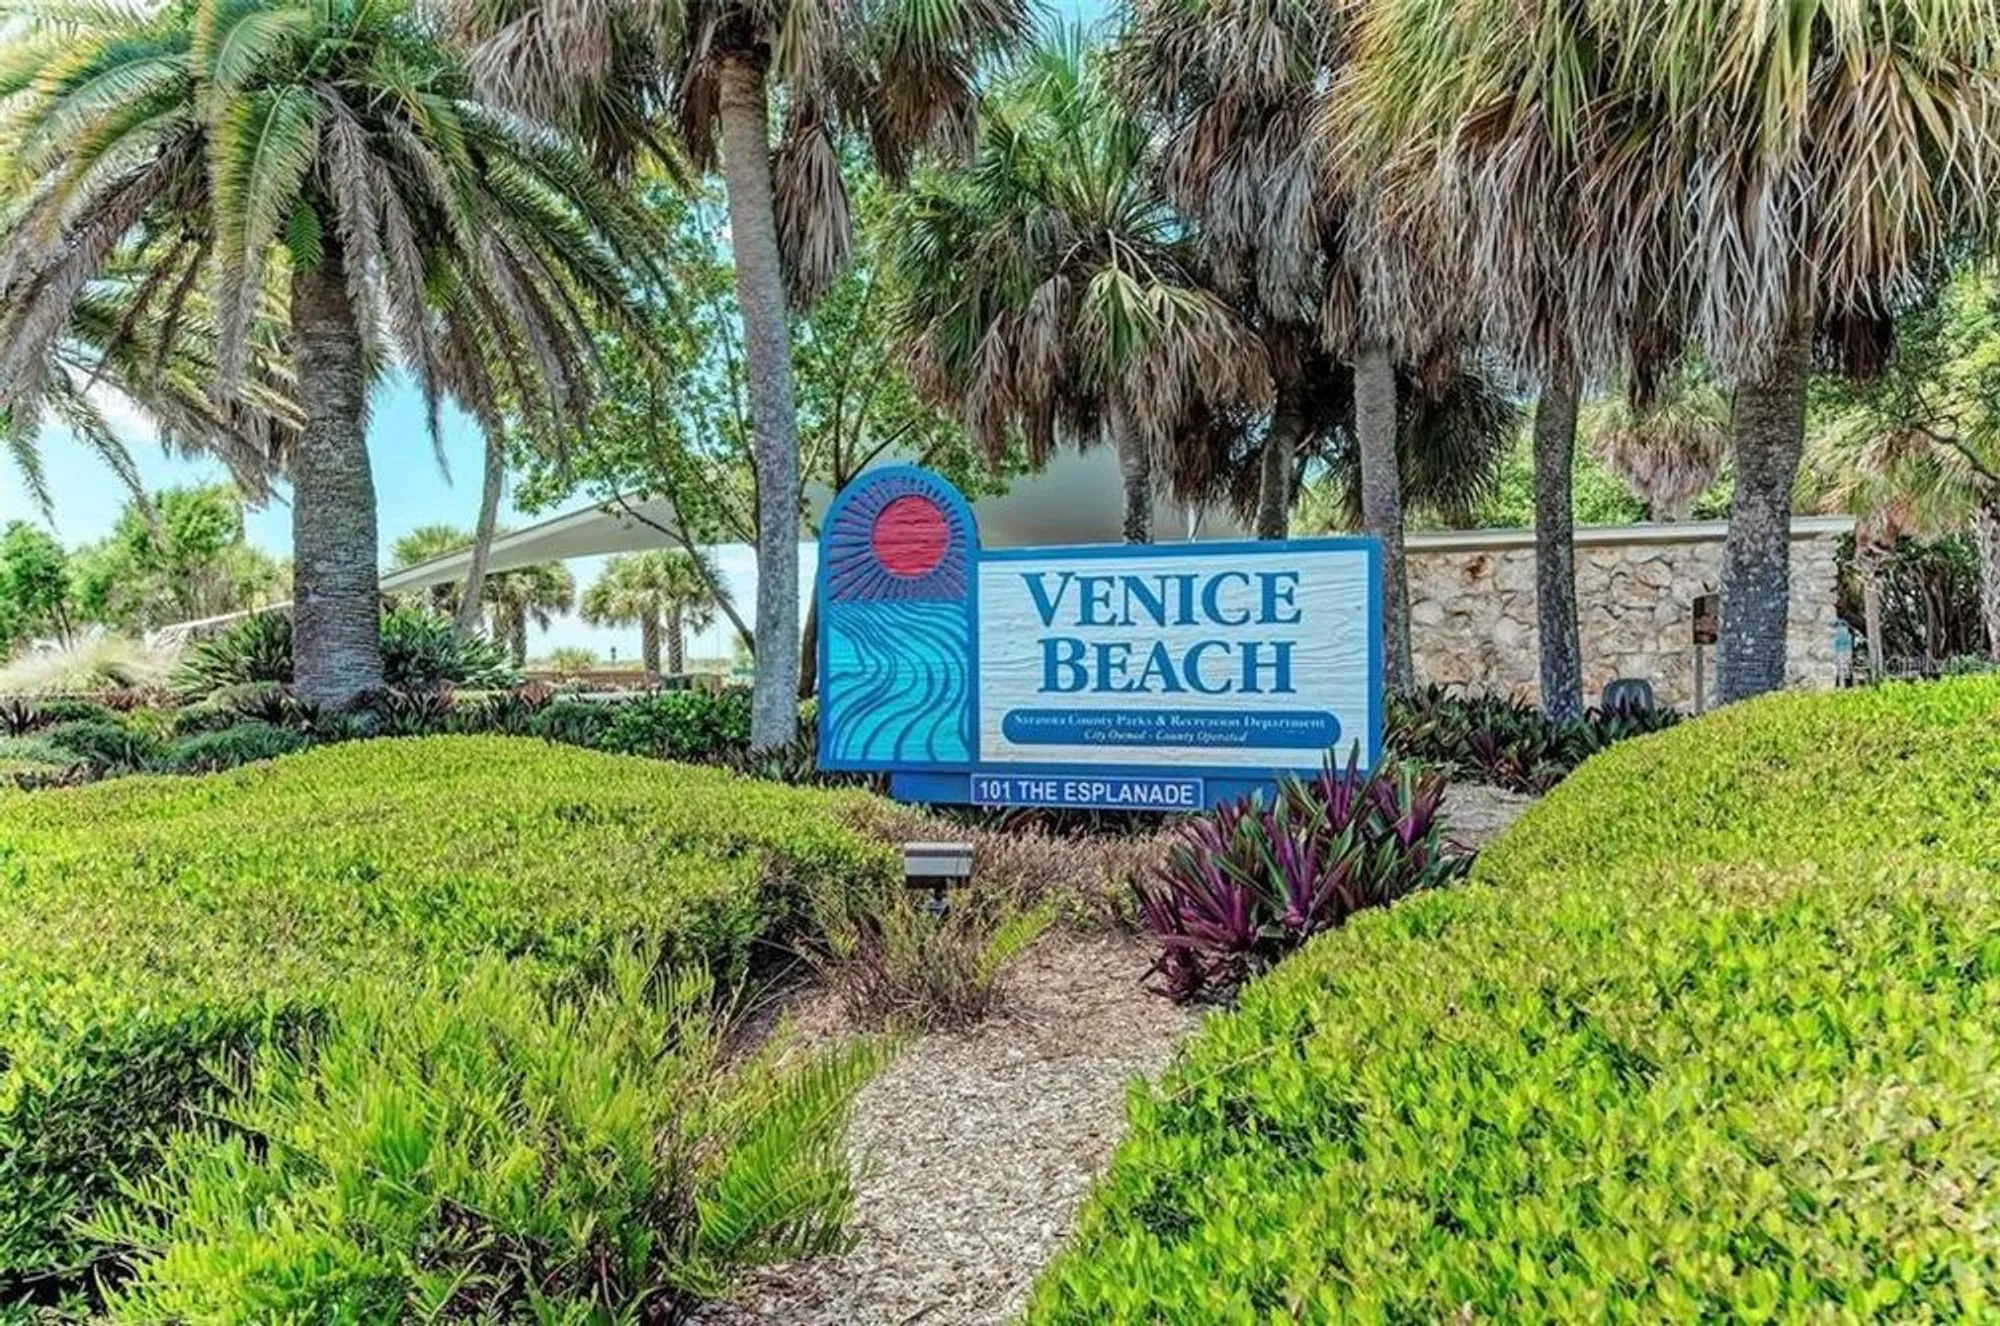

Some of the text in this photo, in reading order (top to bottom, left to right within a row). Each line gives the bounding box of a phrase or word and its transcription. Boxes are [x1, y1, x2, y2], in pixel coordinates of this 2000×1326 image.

[1020, 571, 1302, 627] VENICE
[1037, 637, 1297, 695] BEACH
[1156, 715, 1166, 727] &
[979, 781, 1194, 805] 101 THE ESPLANADE
